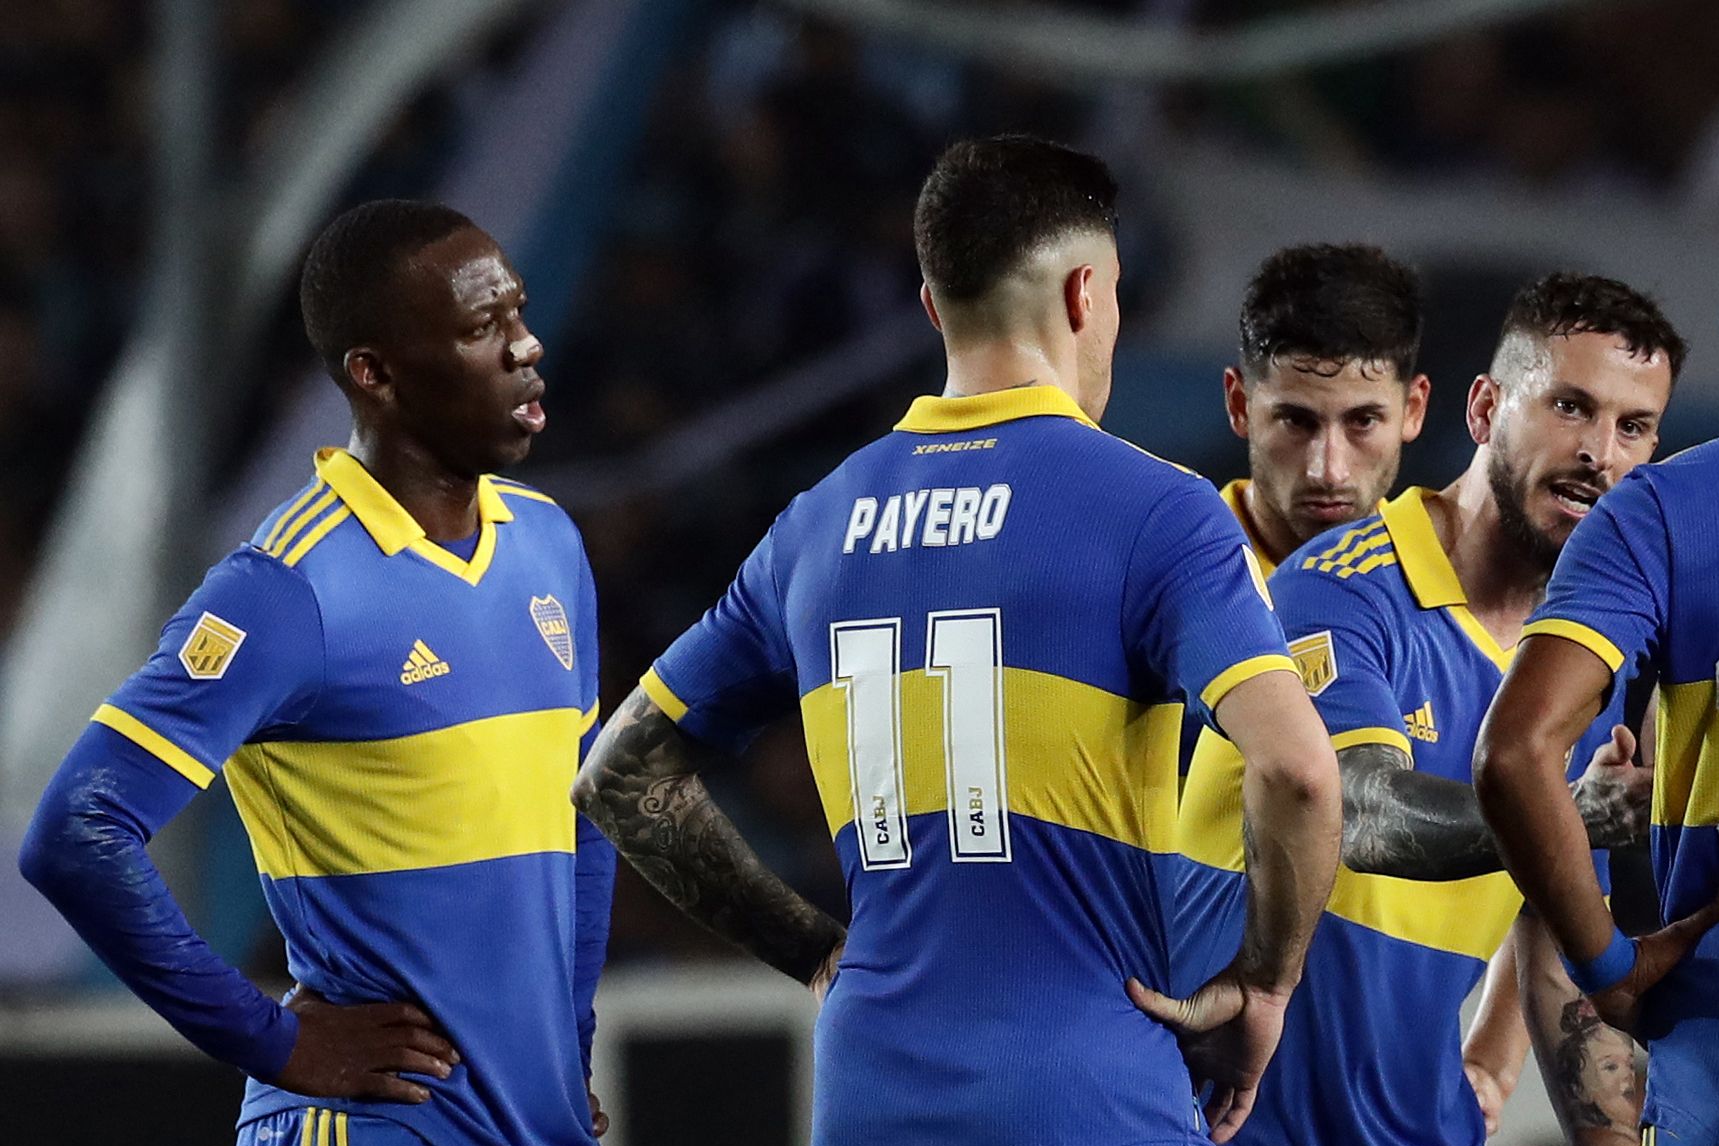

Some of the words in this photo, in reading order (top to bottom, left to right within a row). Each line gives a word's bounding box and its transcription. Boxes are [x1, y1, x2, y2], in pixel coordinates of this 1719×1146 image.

[911, 438, 998, 456] XENEIZE
[842, 483, 1014, 554] PAYERO
[400, 661, 451, 685] adidas
[829, 607, 1013, 872] 11
[872, 794, 890, 846] CABJ
[968, 786, 985, 838] CABJ
